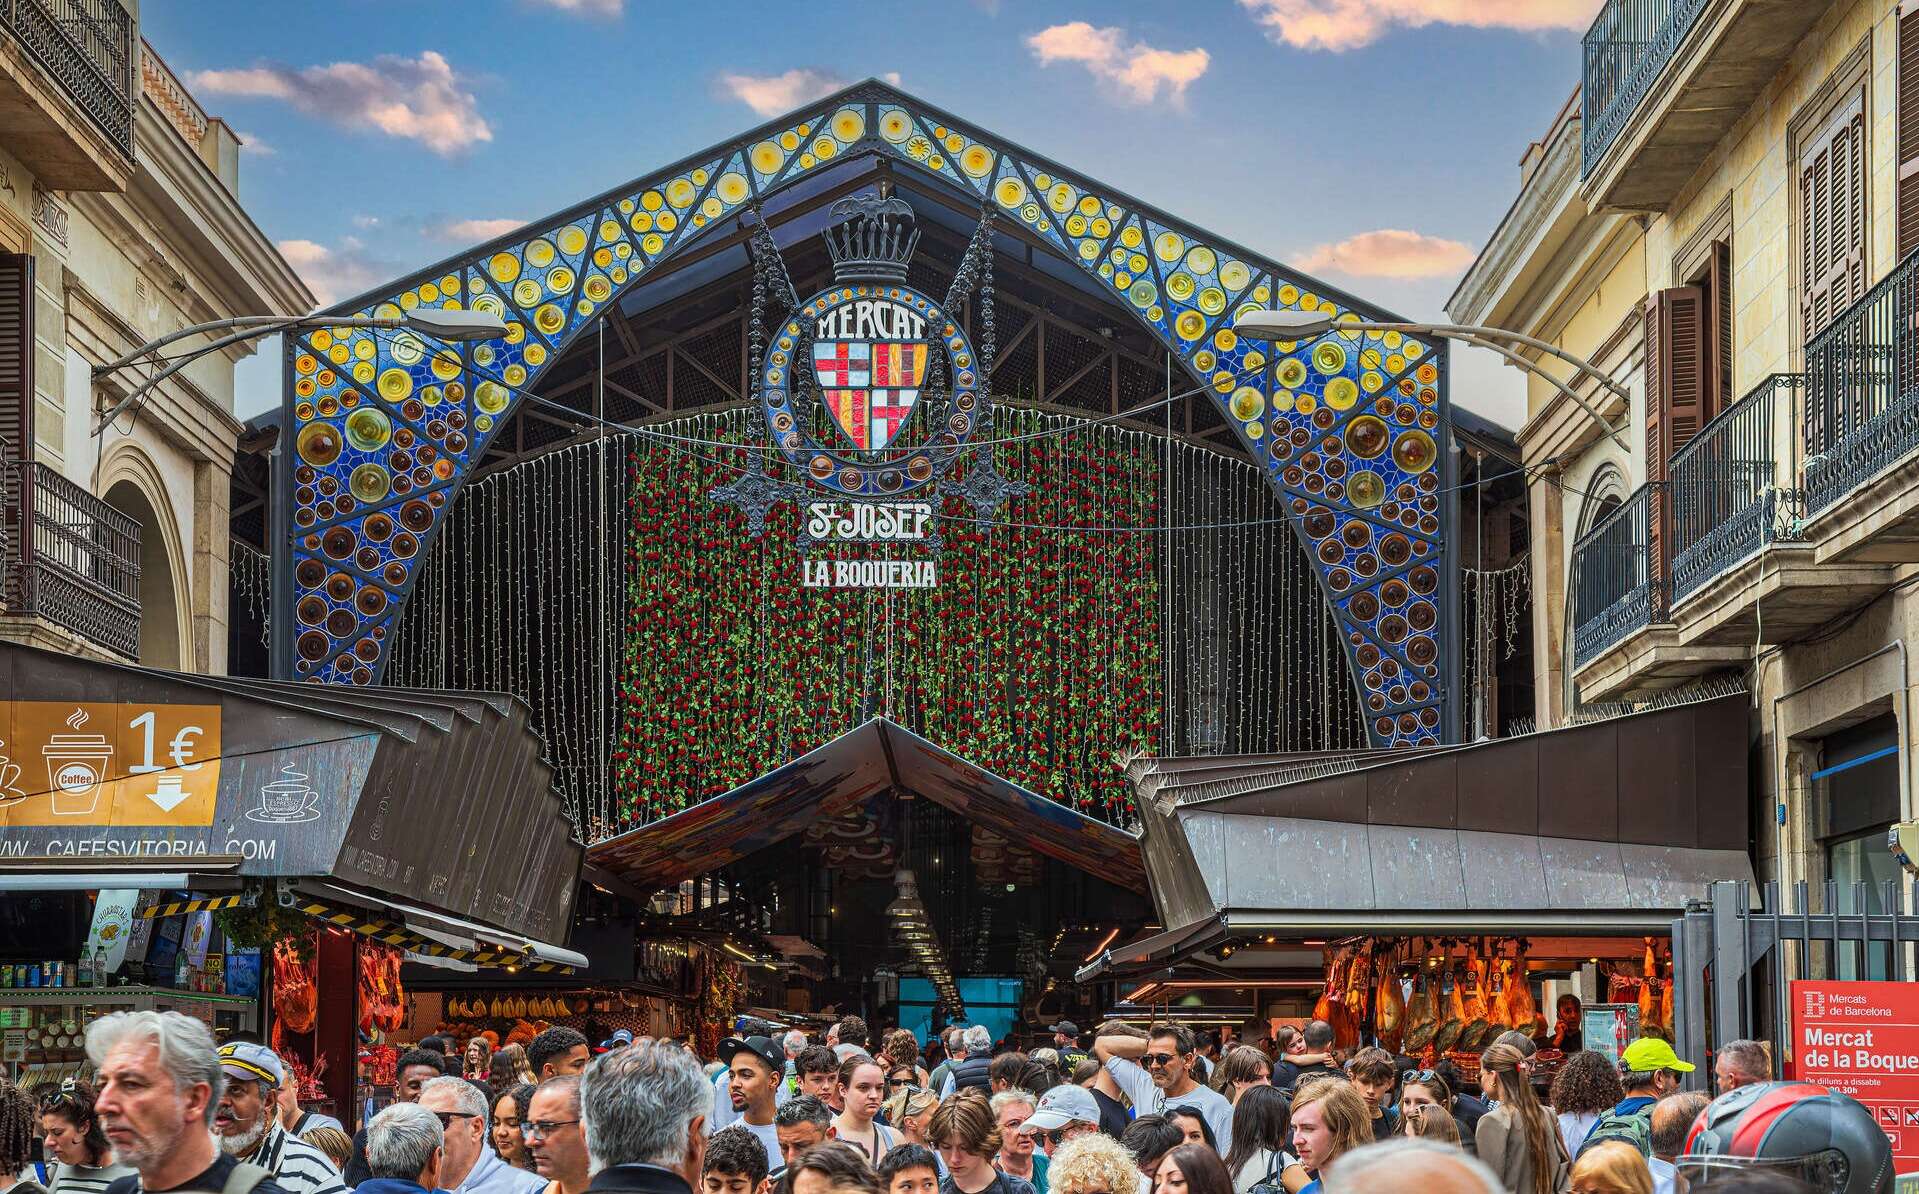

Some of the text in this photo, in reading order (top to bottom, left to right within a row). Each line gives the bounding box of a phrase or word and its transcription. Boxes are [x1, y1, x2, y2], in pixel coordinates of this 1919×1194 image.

[818, 300, 926, 339] MERCAT
[837, 503, 931, 539] JOSEP
[803, 560, 937, 588] LA BOQUERIA
[61, 774, 92, 785] Coffee
[1829, 994, 1867, 1004] Mercats
[1829, 1007, 1892, 1017] de Barcelona
[1805, 1027, 1874, 1048] Mercat
[1805, 1049, 1919, 1073] de la Boque
[1817, 1077, 1843, 1085] dilluns
[1850, 1078, 1882, 1086] dissabte
